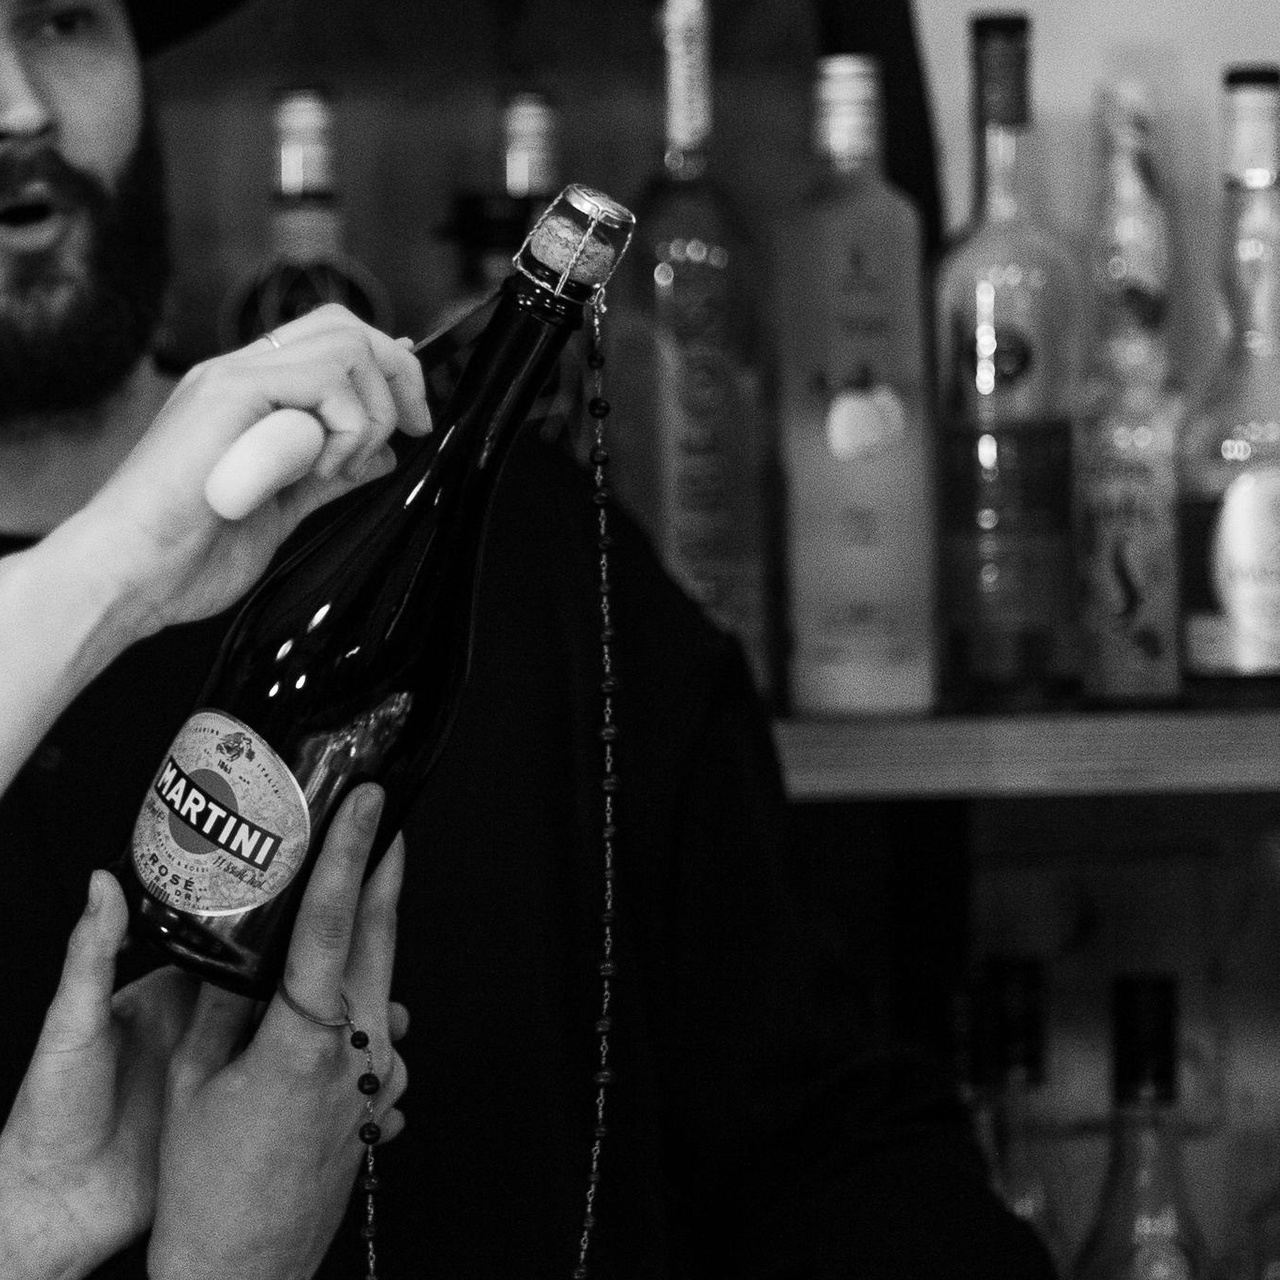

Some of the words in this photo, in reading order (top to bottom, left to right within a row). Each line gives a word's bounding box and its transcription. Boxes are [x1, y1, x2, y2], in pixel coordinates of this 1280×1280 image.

[157, 761, 275, 866] MARTINI
[139, 853, 167, 889] EXTRA
[174, 889, 202, 903] DRY
[149, 853, 195, 892] ROSÉ
